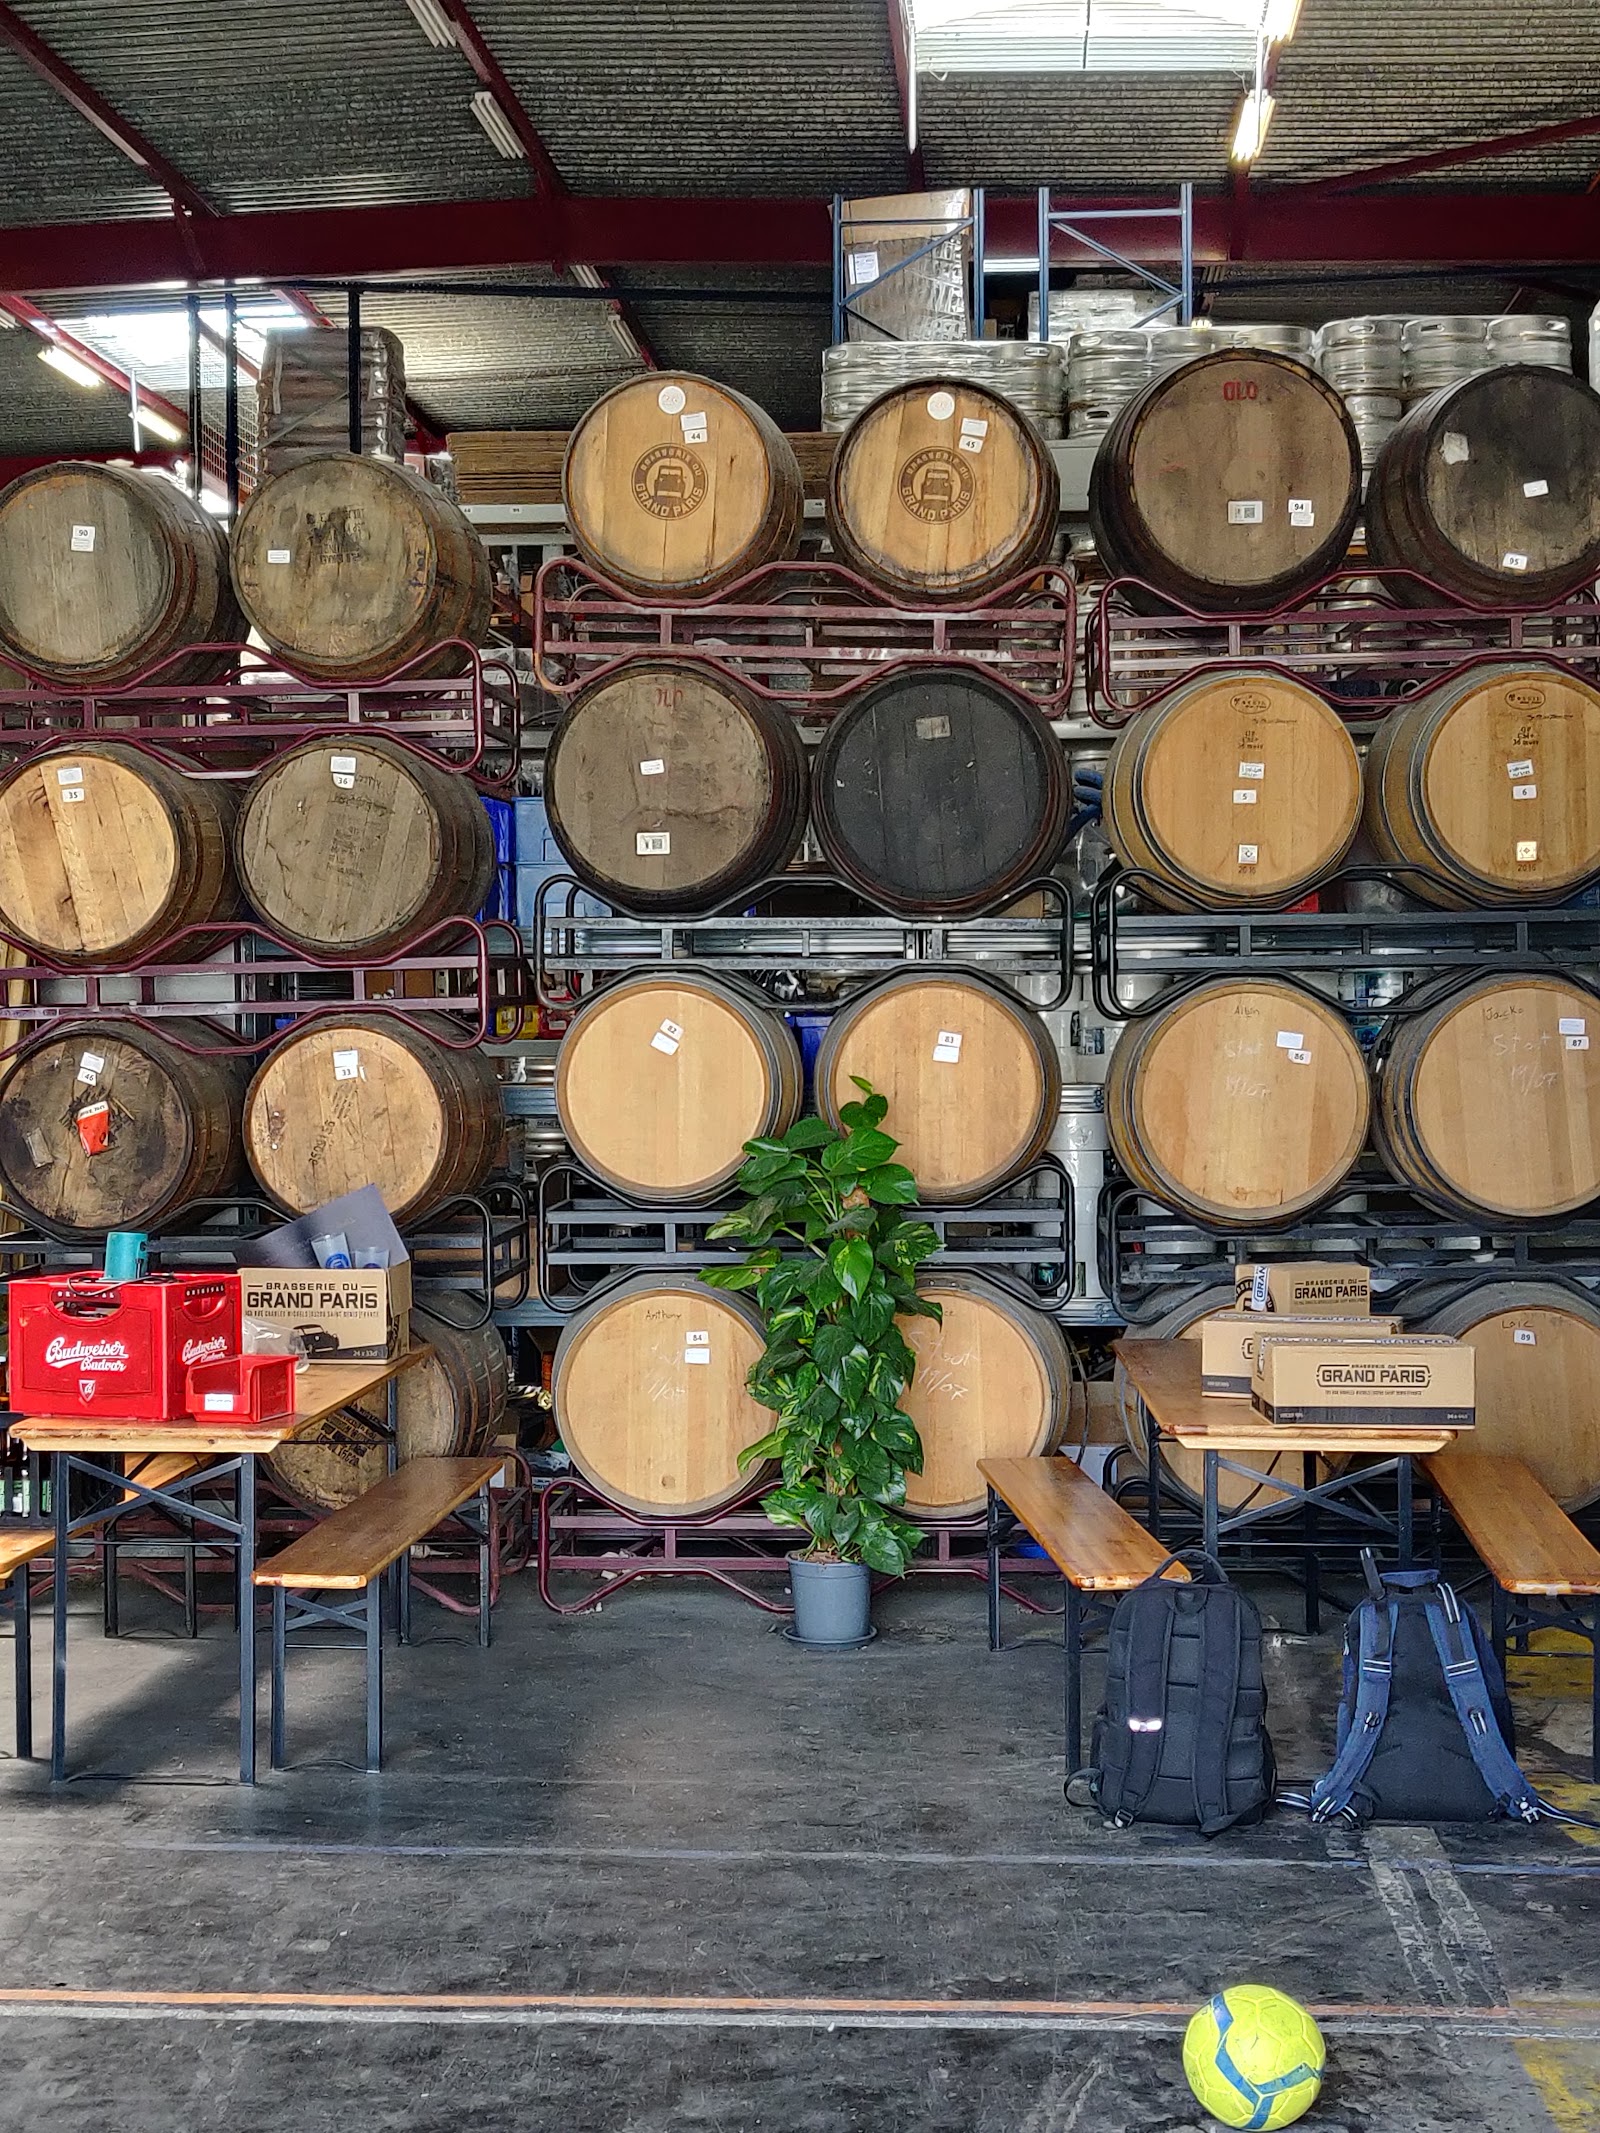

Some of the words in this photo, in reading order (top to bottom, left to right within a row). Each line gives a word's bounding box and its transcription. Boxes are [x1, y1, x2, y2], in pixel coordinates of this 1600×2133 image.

[635, 482, 670, 517] GRAND
[672, 486, 703, 517] PARIS
[901, 486, 936, 520] GRAND
[940, 490, 971, 520] PARIS
[338, 777, 348, 785] 36
[68, 791, 78, 799] 35
[57, 1290, 114, 1299] ORAL
[265, 1282, 336, 1291] BRASSERIE
[342, 1283, 358, 1291] DU
[1294, 1286, 1333, 1299] GRAND
[1335, 1285, 1368, 1298] PARIS
[247, 1291, 313, 1309] GRAND
[320, 1292, 378, 1309] PARIS
[45, 1336, 129, 1368] Budweiser
[182, 1336, 228, 1365] Budweiser
[80, 1355, 127, 1373] Budvar
[1322, 1369, 1375, 1383] GRAND
[1380, 1370, 1426, 1384] PARIS
